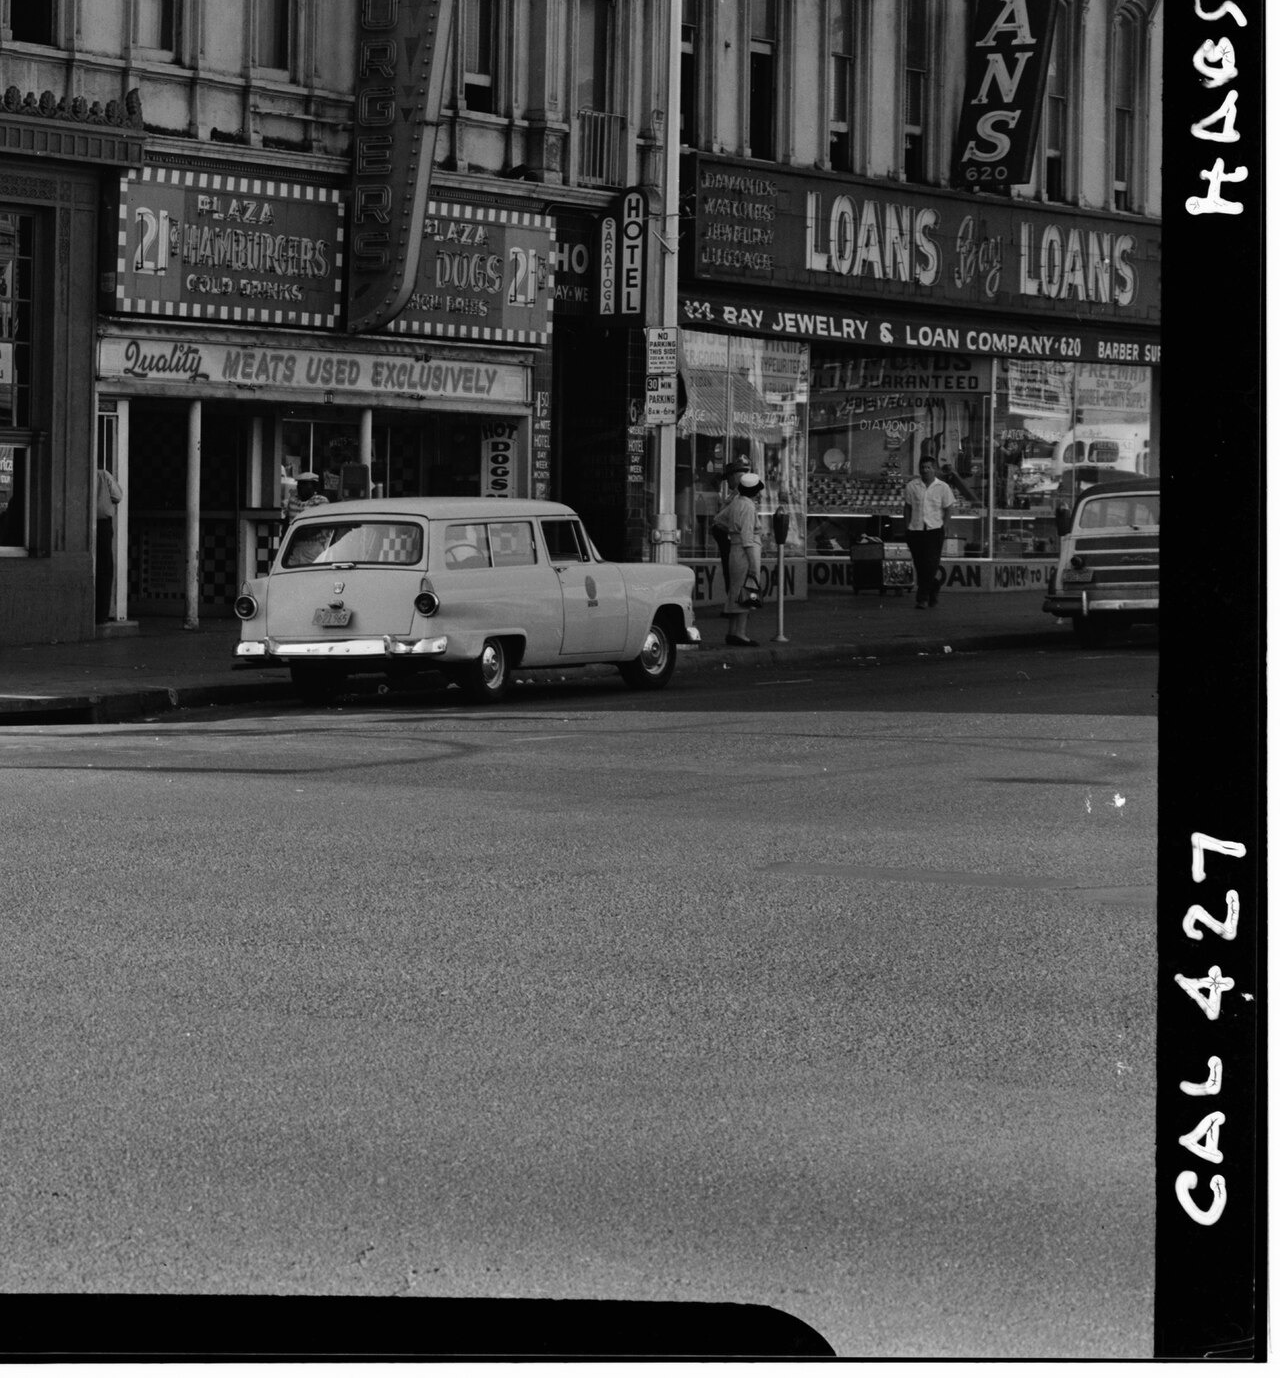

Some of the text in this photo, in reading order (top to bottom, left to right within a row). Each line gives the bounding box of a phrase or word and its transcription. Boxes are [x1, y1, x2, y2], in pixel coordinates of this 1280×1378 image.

[965, 166, 1008, 181] 620
[197, 194, 276, 226] PLAZA
[424, 219, 489, 247] PLAZA
[182, 224, 331, 279] HAMBURGERS
[623, 197, 643, 312] HOTEL
[804, 190, 943, 287] LOANS
[1019, 221, 1140, 307] LOANS
[435, 249, 504, 294] DOGS
[602, 219, 614, 314] SARATOGA
[186, 274, 306, 302] COLD DRINKS
[657, 332, 668, 341] NO
[722, 305, 764, 329] BAY
[771, 311, 869, 341] JEWELRY
[879, 321, 894, 344] &
[905, 325, 960, 350] LOAN
[965, 330, 1054, 356] COMPANY
[1060, 336, 1082, 358] 620
[1097, 340, 1140, 362] BARBER
[123, 340, 498, 397] Quality MEATS USED EXCLUSIVELY
[647, 379, 658, 390] 30
[648, 394, 675, 404] PARKING
[481, 422, 519, 440] HOT
[859, 419, 926, 433] DIAMONDS
[490, 441, 512, 491] DOGS
[994, 565, 1028, 588] MONEY
[1030, 570, 1041, 583] TO
